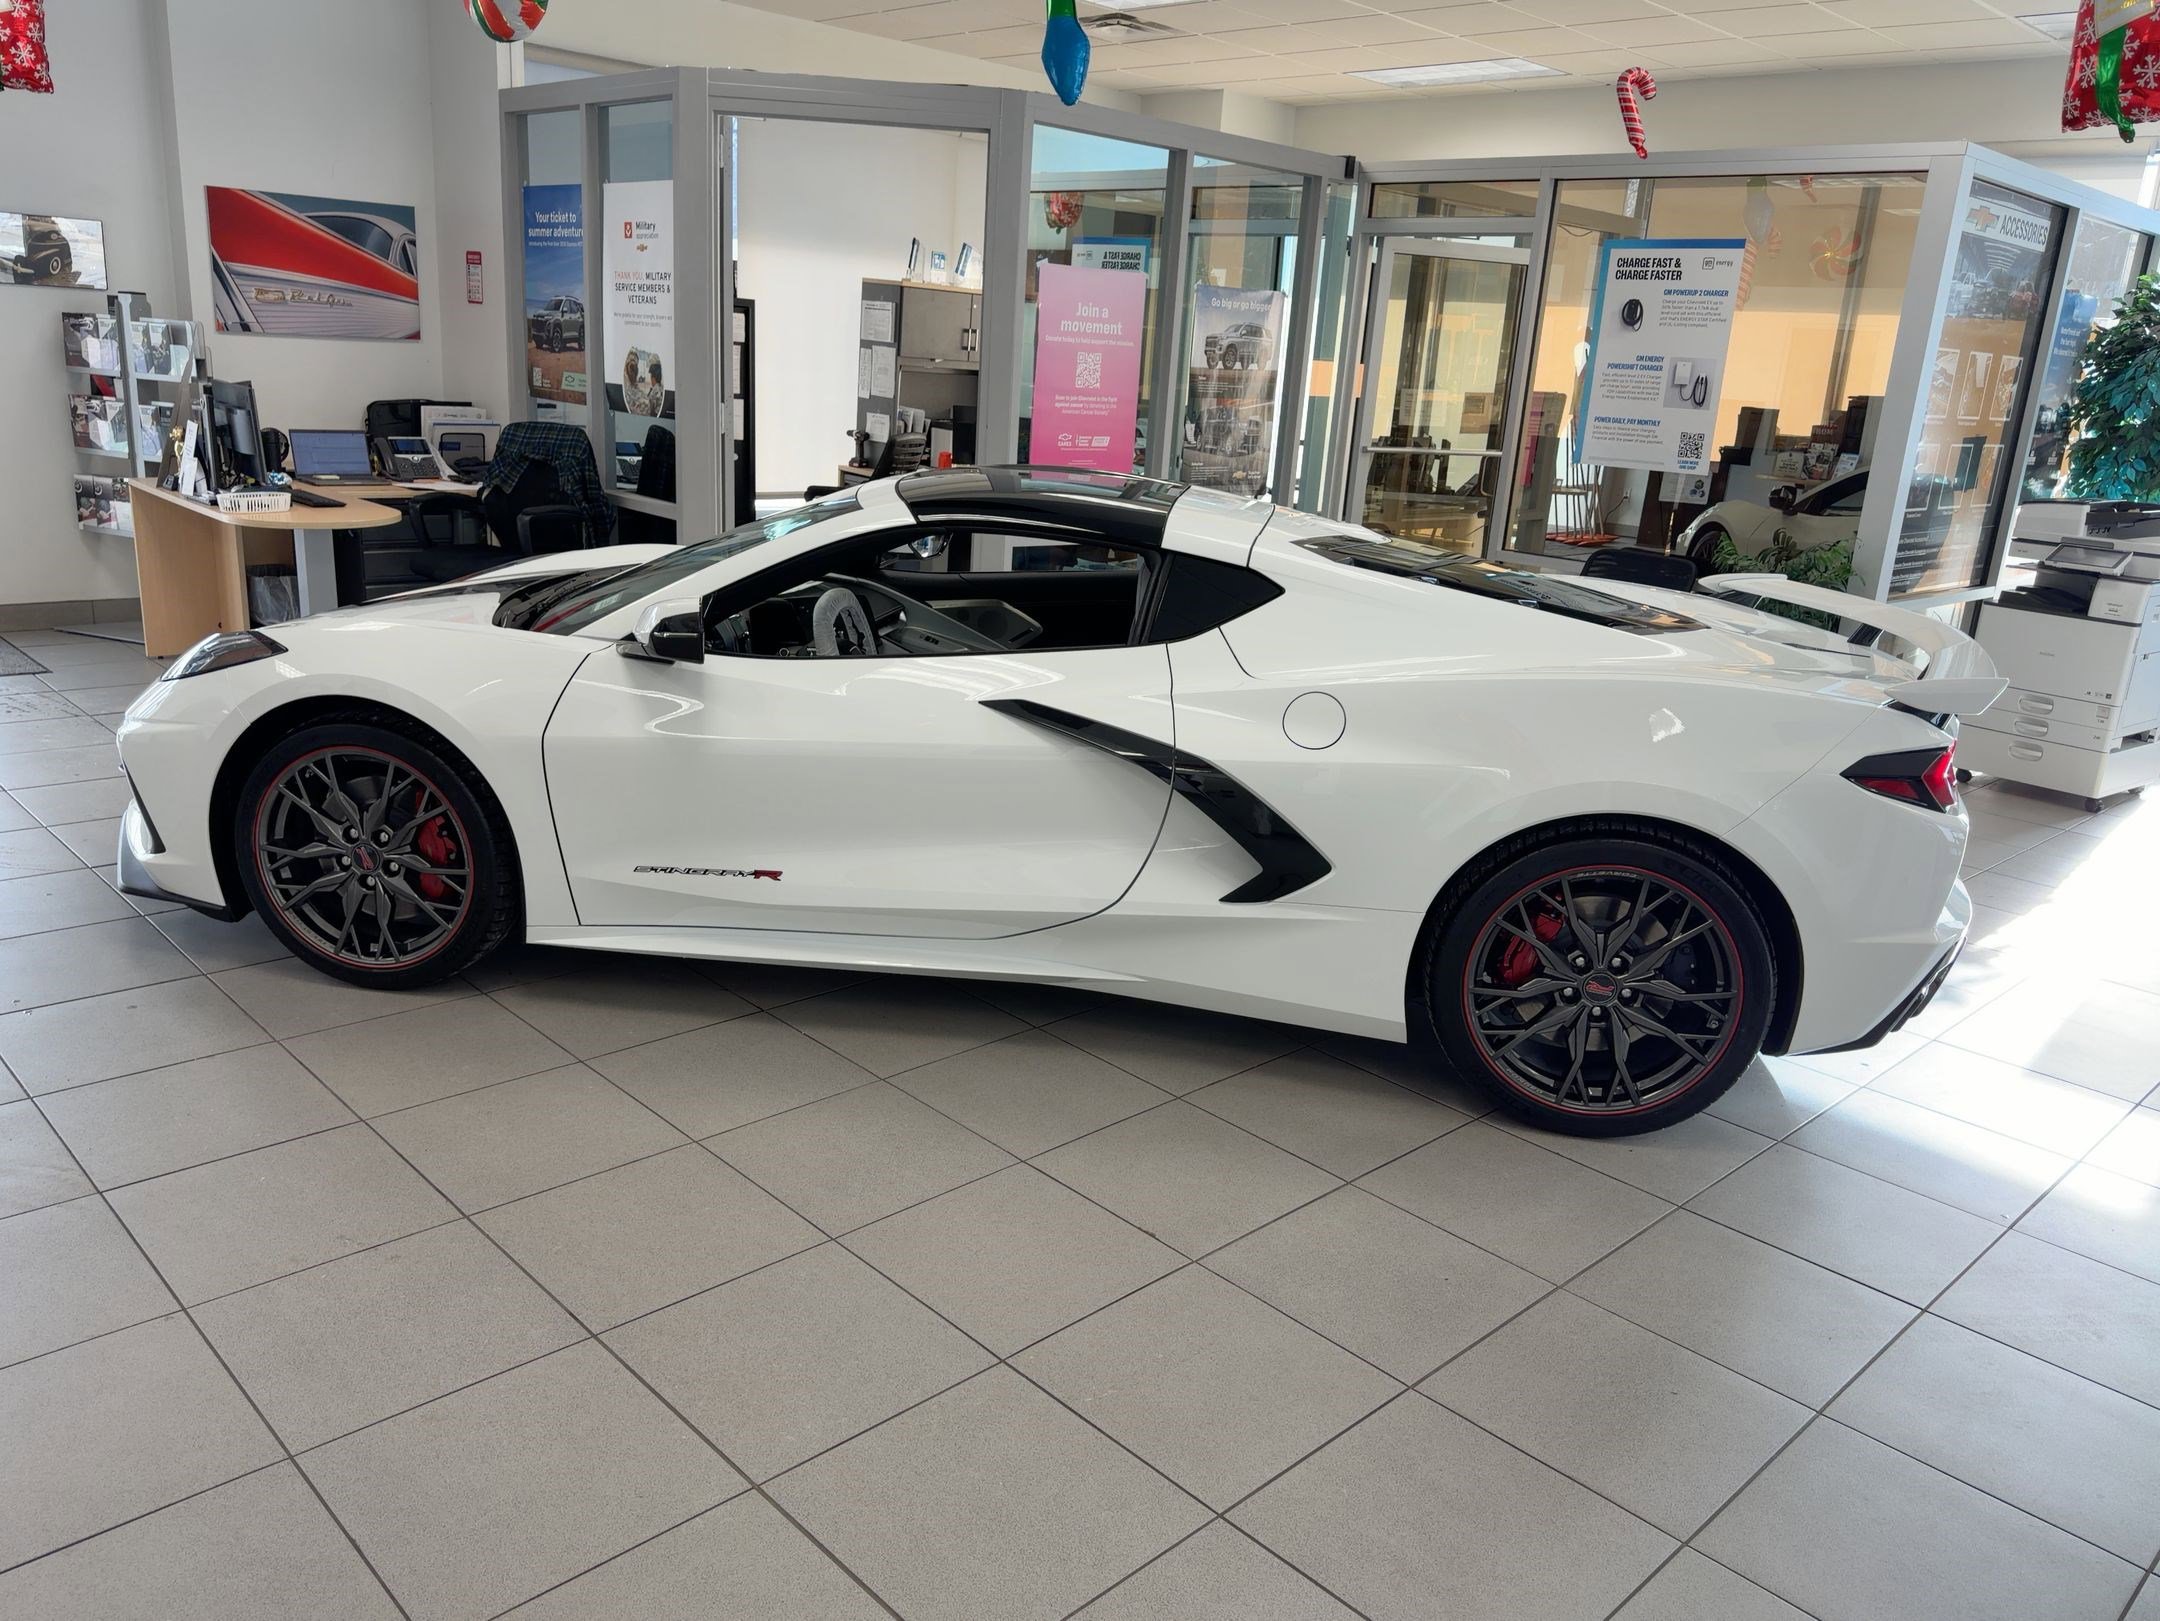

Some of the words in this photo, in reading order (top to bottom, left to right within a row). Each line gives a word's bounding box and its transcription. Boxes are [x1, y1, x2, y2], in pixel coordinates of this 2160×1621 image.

[535, 212, 549, 223] Your
[550, 211, 568, 223] ticket
[570, 212, 576, 223] to
[636, 221, 656, 232] Military
[2000, 215, 2048, 246] ACCESSORIES
[528, 228, 552, 237] summer
[1617, 258, 1651, 268] CHARGE
[1652, 258, 1673, 268] FAST
[1674, 258, 1682, 268] &
[614, 271, 630, 280] THANK
[646, 272, 671, 280] MILITARY
[1615, 270, 1649, 280] CHARGE
[1650, 270, 1682, 280] FASTER
[615, 283, 636, 292] SERVICE
[638, 284, 665, 293] MEMBERS
[667, 285, 670, 293] &
[628, 295, 656, 304] VETERANS
[1211, 297, 1220, 307] Go
[1222, 298, 1232, 310] big
[1233, 301, 1240, 309] or
[1241, 301, 1249, 310] go
[1076, 302, 1099, 317] Join
[1102, 308, 1108, 317] a
[1061, 320, 1122, 335] movement
[1645, 355, 1664, 363] ENERGY
[1607, 363, 1639, 371] POWERSHIFT
[1594, 416, 1612, 424] POWER
[1637, 419, 1661, 427] MONTHLY
